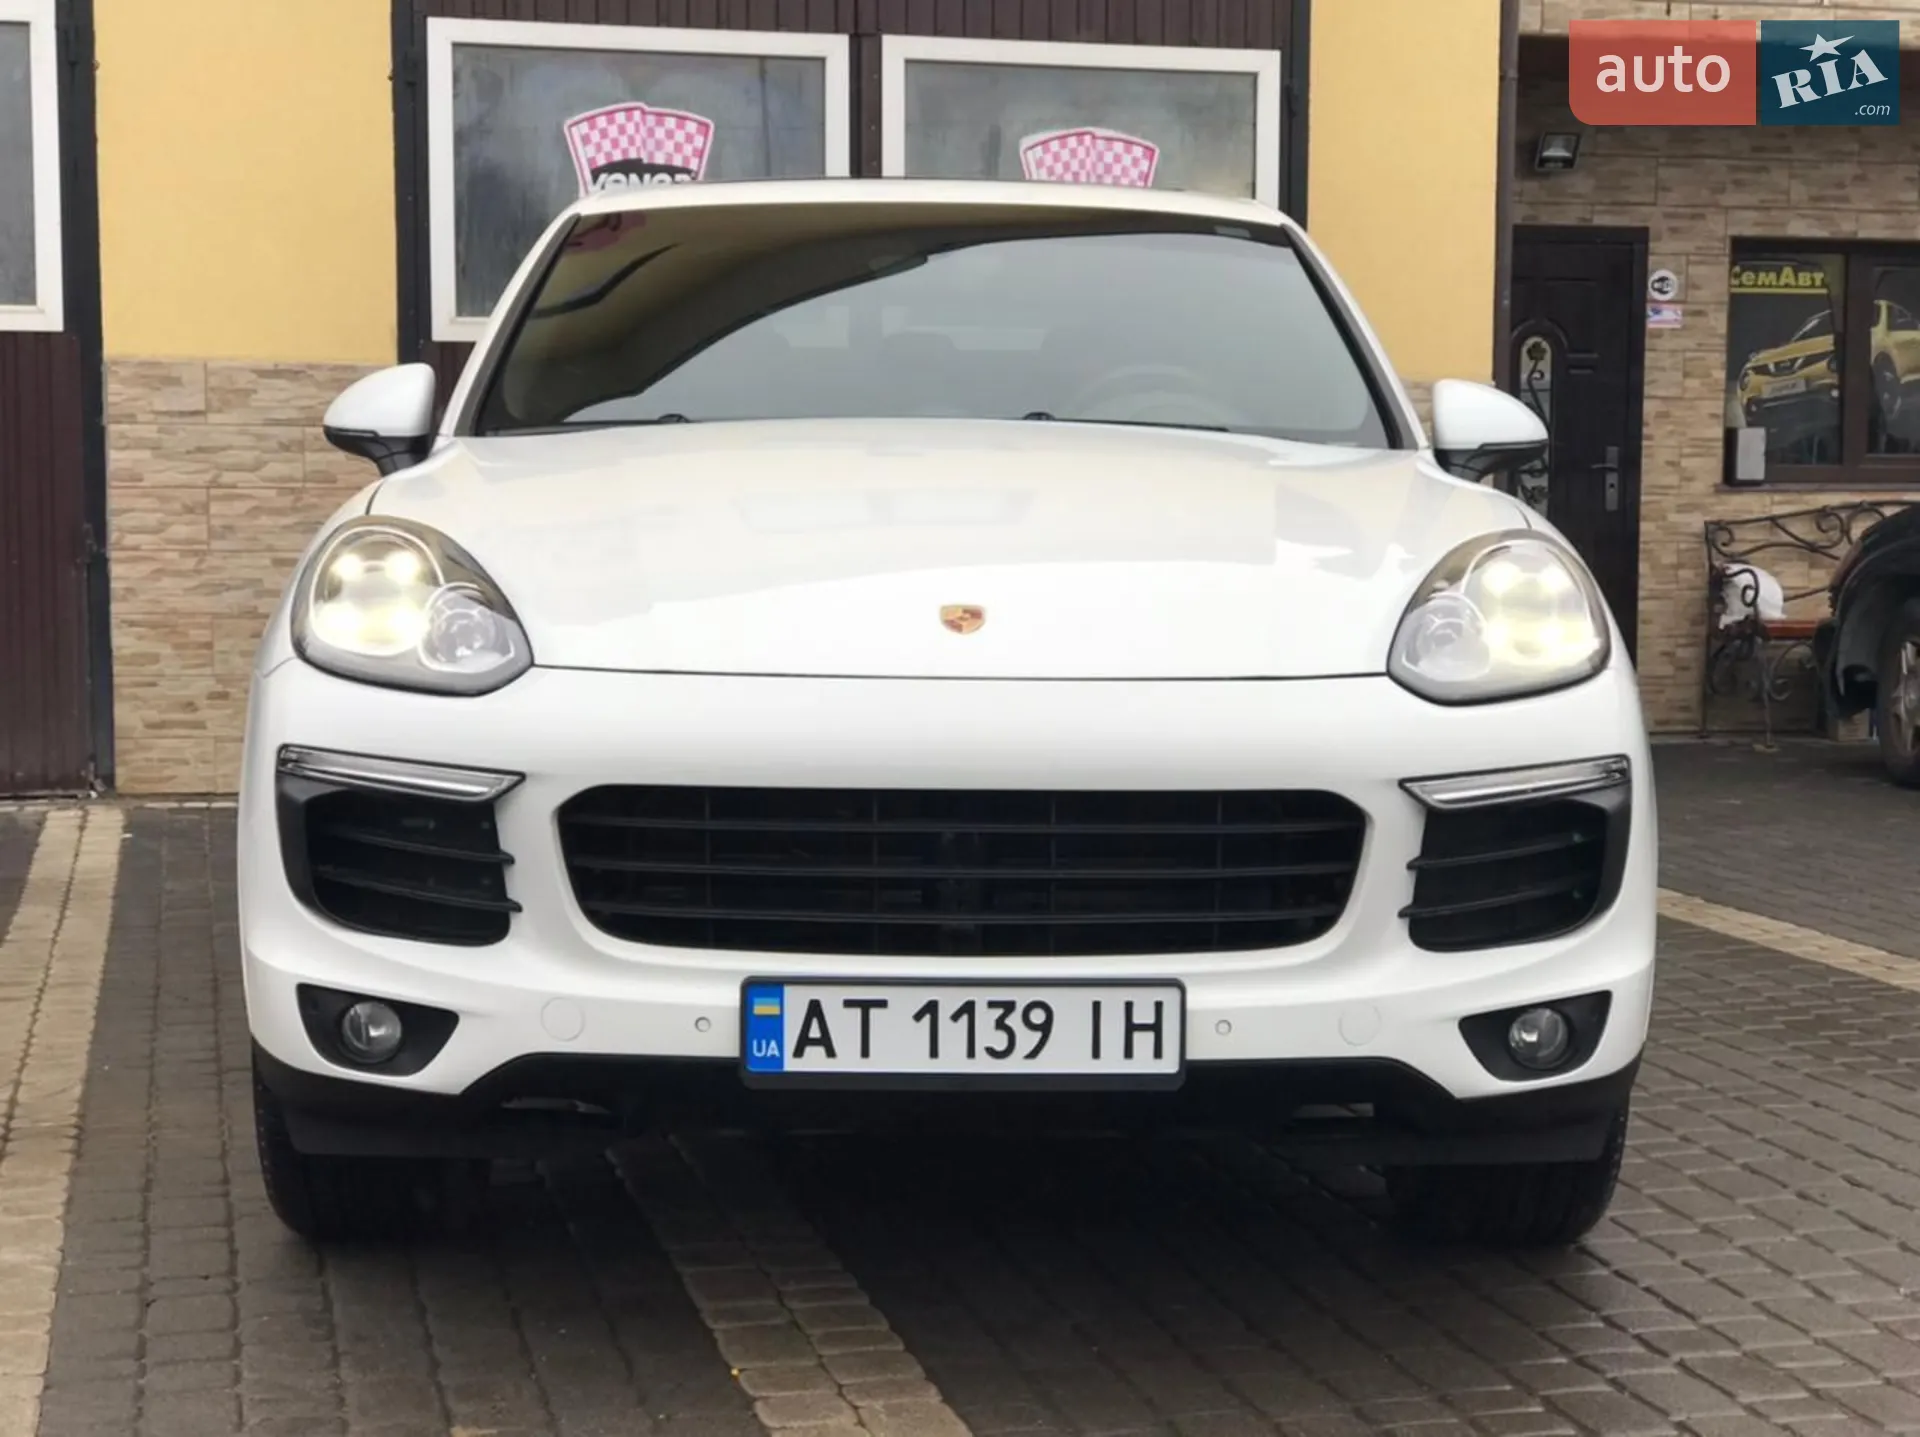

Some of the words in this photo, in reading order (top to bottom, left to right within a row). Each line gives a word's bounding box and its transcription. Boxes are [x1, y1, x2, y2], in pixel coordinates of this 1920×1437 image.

[752, 1039, 780, 1058] UA
[792, 998, 889, 1060] AT
[912, 999, 1055, 1060] 1139
[1091, 999, 1164, 1060] IH
